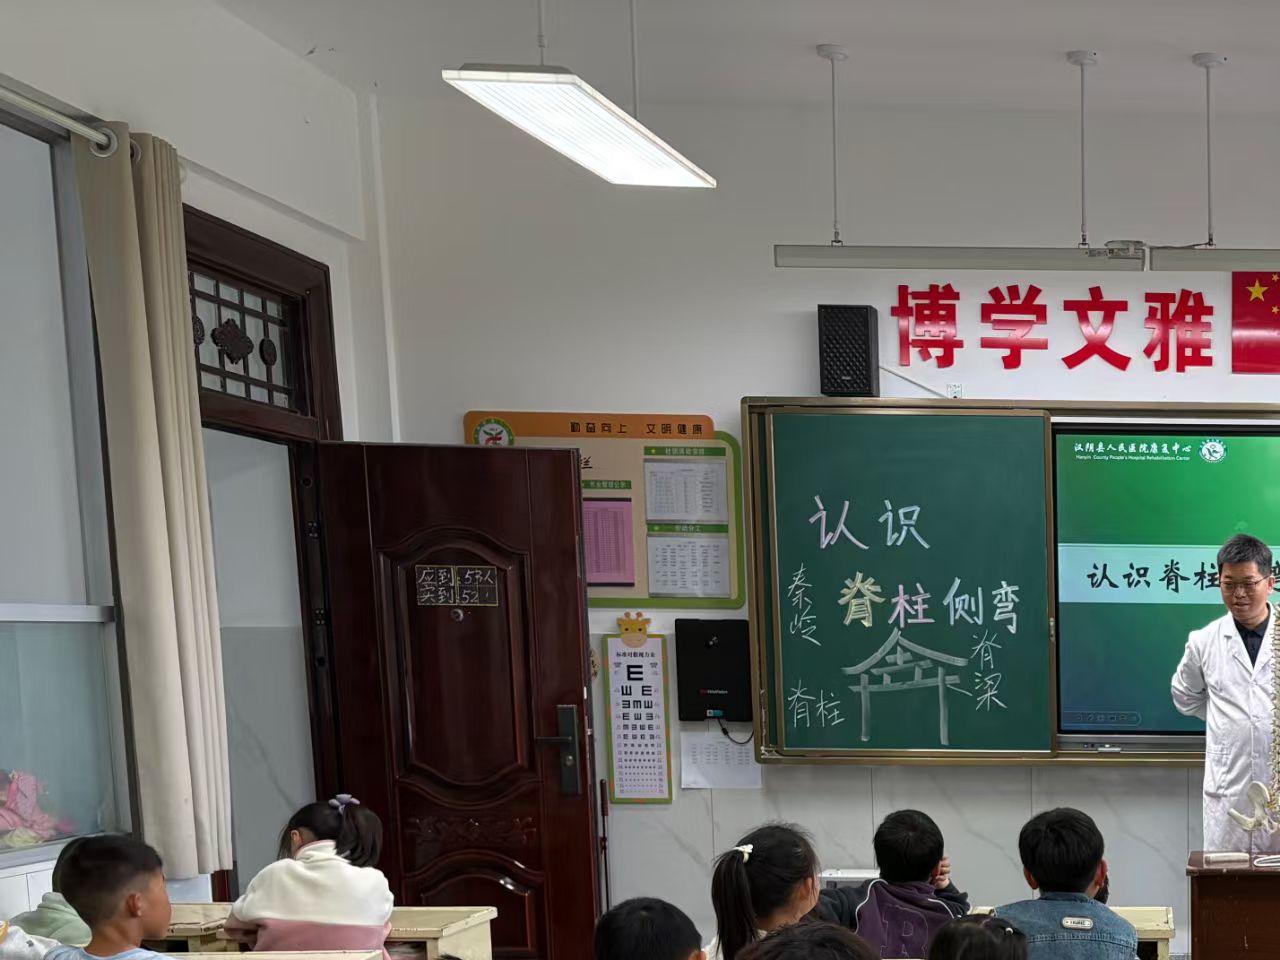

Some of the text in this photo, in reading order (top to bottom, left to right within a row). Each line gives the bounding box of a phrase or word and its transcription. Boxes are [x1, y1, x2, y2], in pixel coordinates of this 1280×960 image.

[890, 283, 1214, 373] 博学文雅
[646, 423, 703, 435] 文明健康
[1074, 441, 1192, 454] 汉阴县人民医院康复中心
[808, 495, 931, 550] 认识
[787, 563, 822, 646] 秦岭
[838, 571, 1020, 634] 脊柱侧弯
[788, 677, 845, 728] 脊柱
